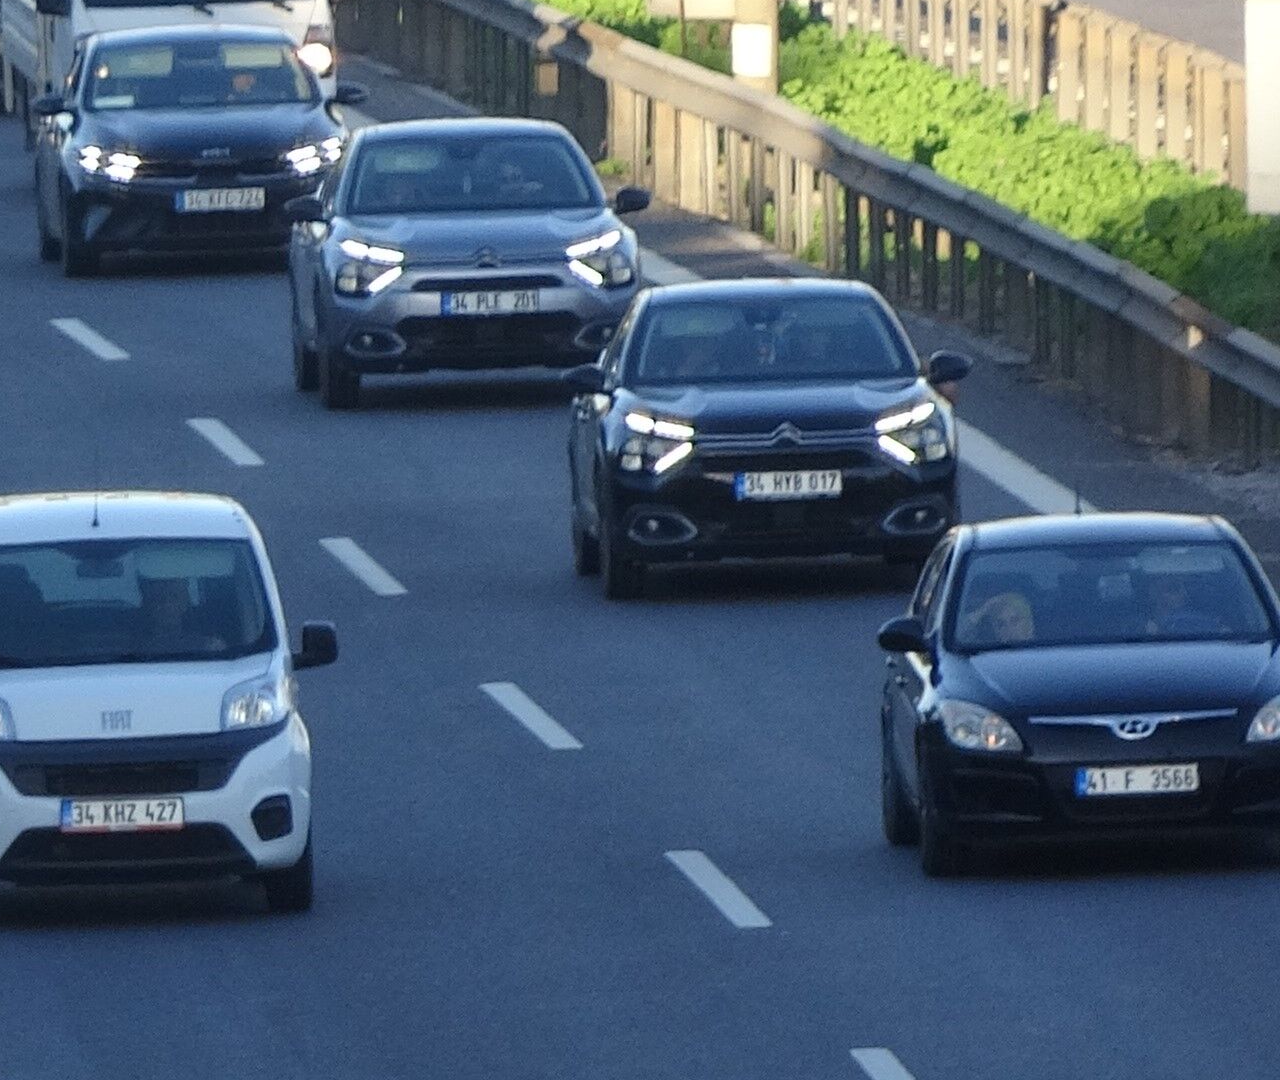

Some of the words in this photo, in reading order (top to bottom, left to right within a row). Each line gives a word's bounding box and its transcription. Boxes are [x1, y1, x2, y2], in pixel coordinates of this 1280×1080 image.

[452, 292, 469, 311] 34
[747, 473, 765, 493] 34
[809, 471, 838, 491] 017
[1087, 771, 1108, 791] 41
[1124, 769, 1136, 790] F
[1151, 766, 1196, 789] 3566
[74, 803, 96, 825] 34
[103, 802, 137, 824] KHZ
[145, 800, 178, 822] 427
